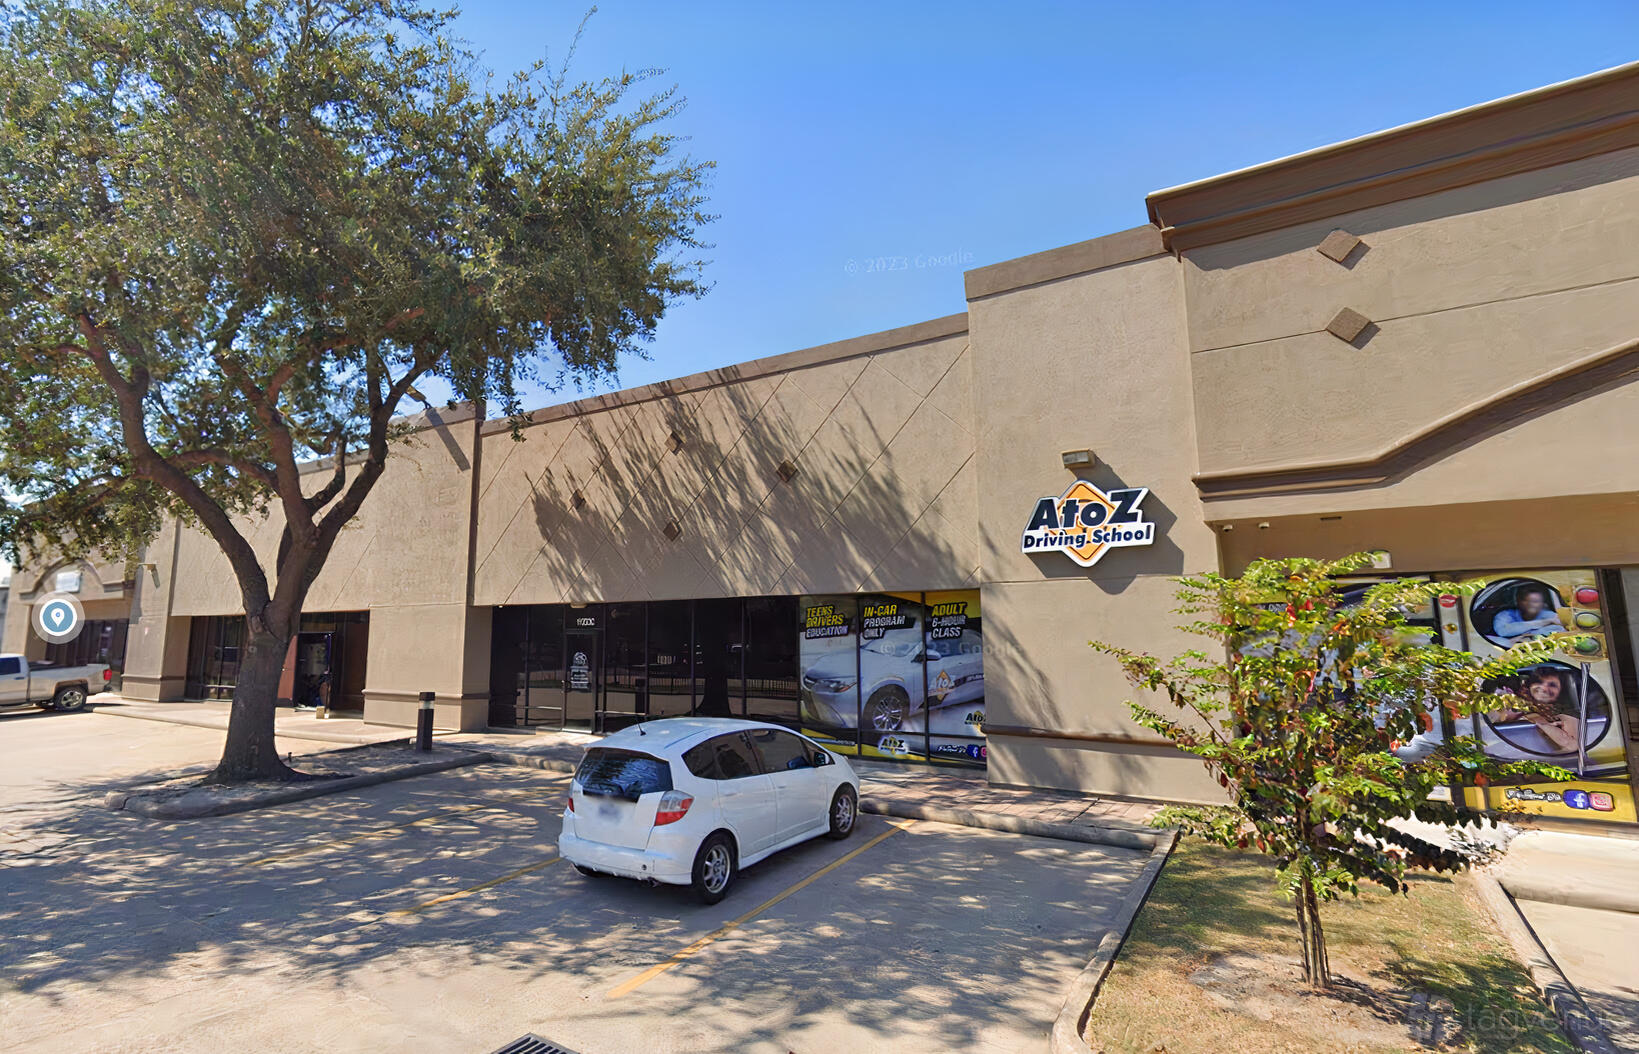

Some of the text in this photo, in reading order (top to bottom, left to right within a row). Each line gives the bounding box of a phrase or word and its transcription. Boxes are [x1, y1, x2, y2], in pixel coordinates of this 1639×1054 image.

[1023, 525, 1151, 548] Driving School
[806, 605, 834, 617] TEENS
[931, 603, 966, 617] ADULT
[805, 614, 844, 628] DRIVERS
[932, 627, 961, 639] CLASS
